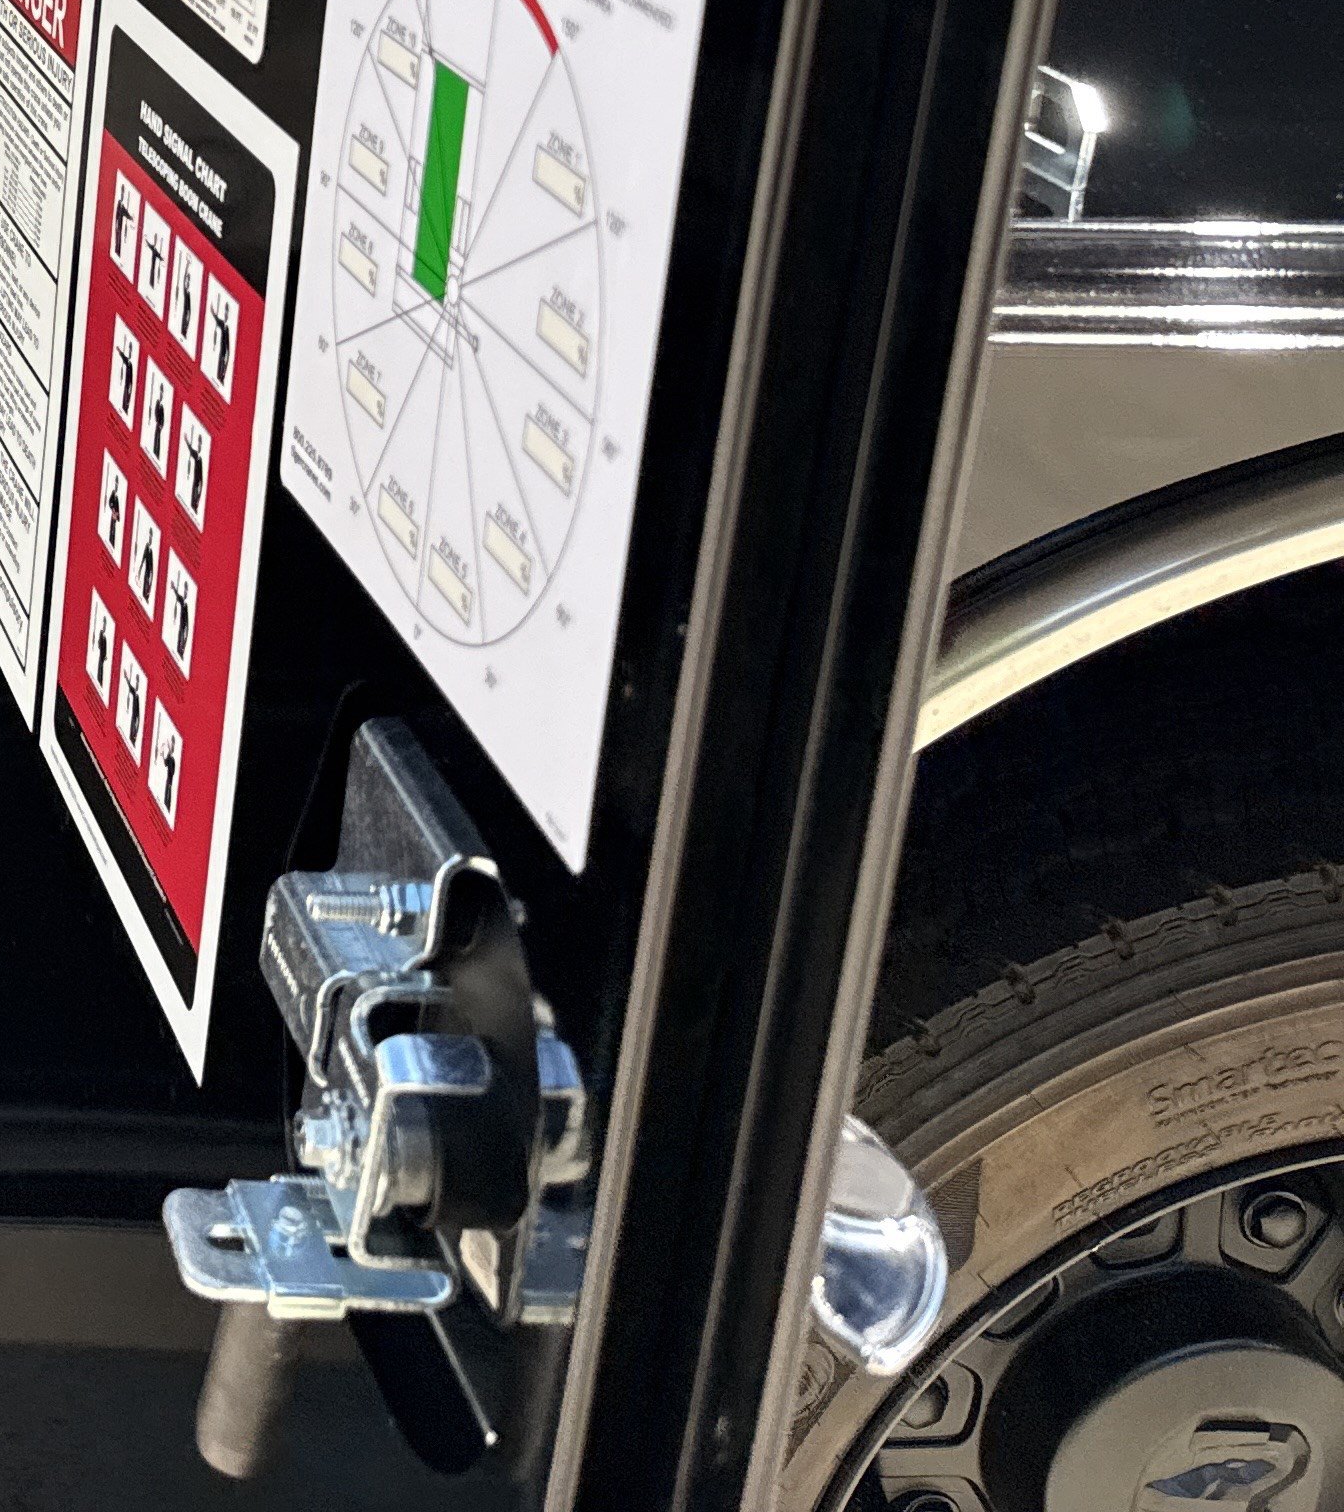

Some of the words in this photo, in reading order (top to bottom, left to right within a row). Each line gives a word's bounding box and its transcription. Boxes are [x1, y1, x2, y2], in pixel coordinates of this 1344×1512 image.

[9, 9, 17, 33] OR
[19, 20, 46, 65] SERIOUS
[47, 52, 71, 94] INJURY
[138, 135, 178, 192] TELESCOPING
[178, 179, 198, 213] BOOM
[198, 200, 223, 240] CRANE
[139, 98, 162, 140] HAND
[163, 123, 194, 172] SIGNAL
[195, 154, 227, 206] CHART
